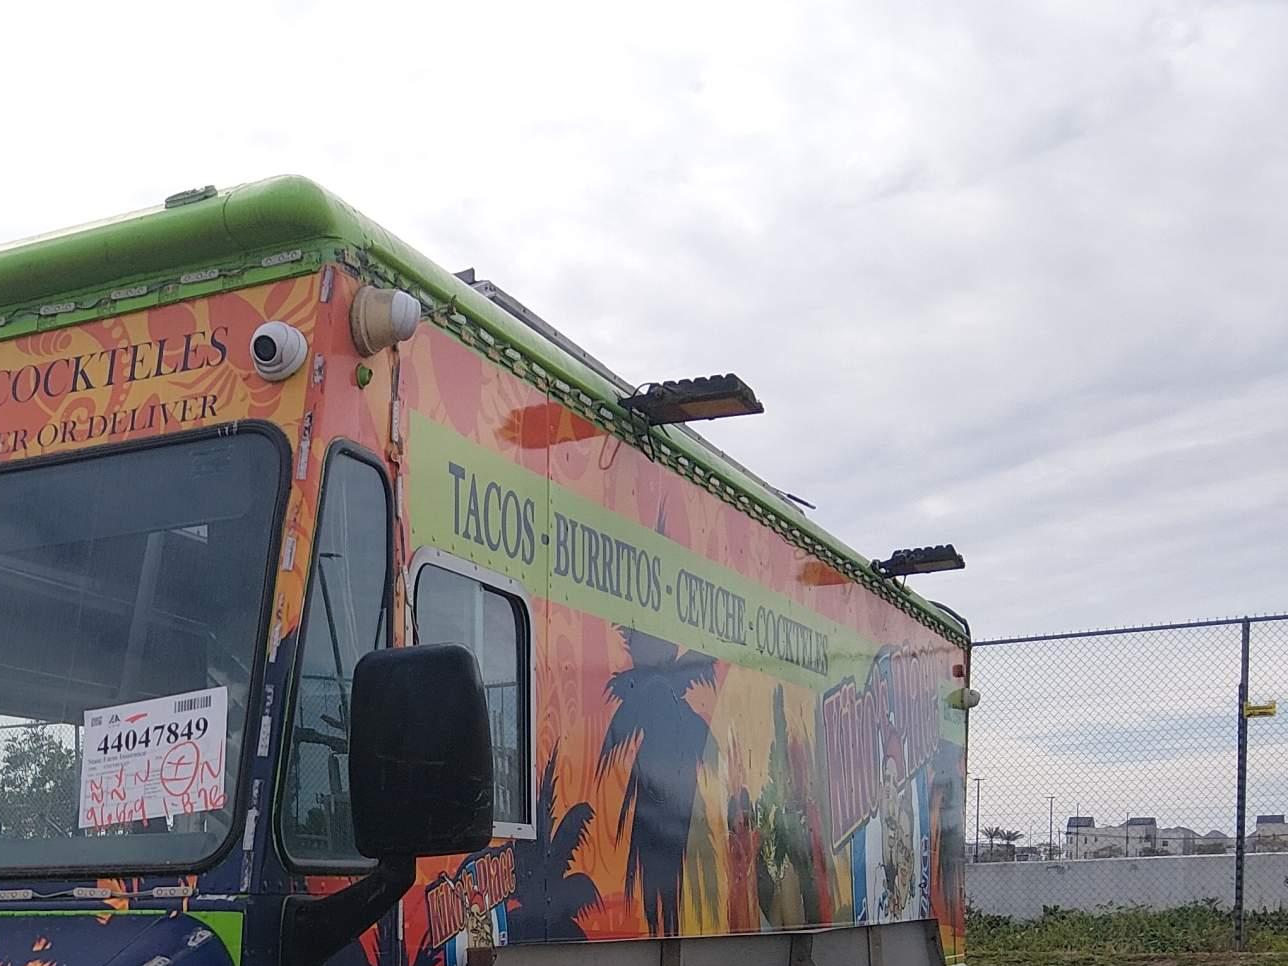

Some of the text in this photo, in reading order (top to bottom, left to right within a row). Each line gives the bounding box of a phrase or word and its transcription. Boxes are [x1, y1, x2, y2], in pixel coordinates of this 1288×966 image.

[36, 419, 80, 449] OR
[86, 393, 219, 438] DELIVER
[448, 461, 536, 566] TACOS
[553, 511, 661, 612] BURRITOS
[676, 568, 747, 646] CEVICHE
[756, 604, 829, 676] COCKTELES
[97, 716, 209, 756] 44047849
